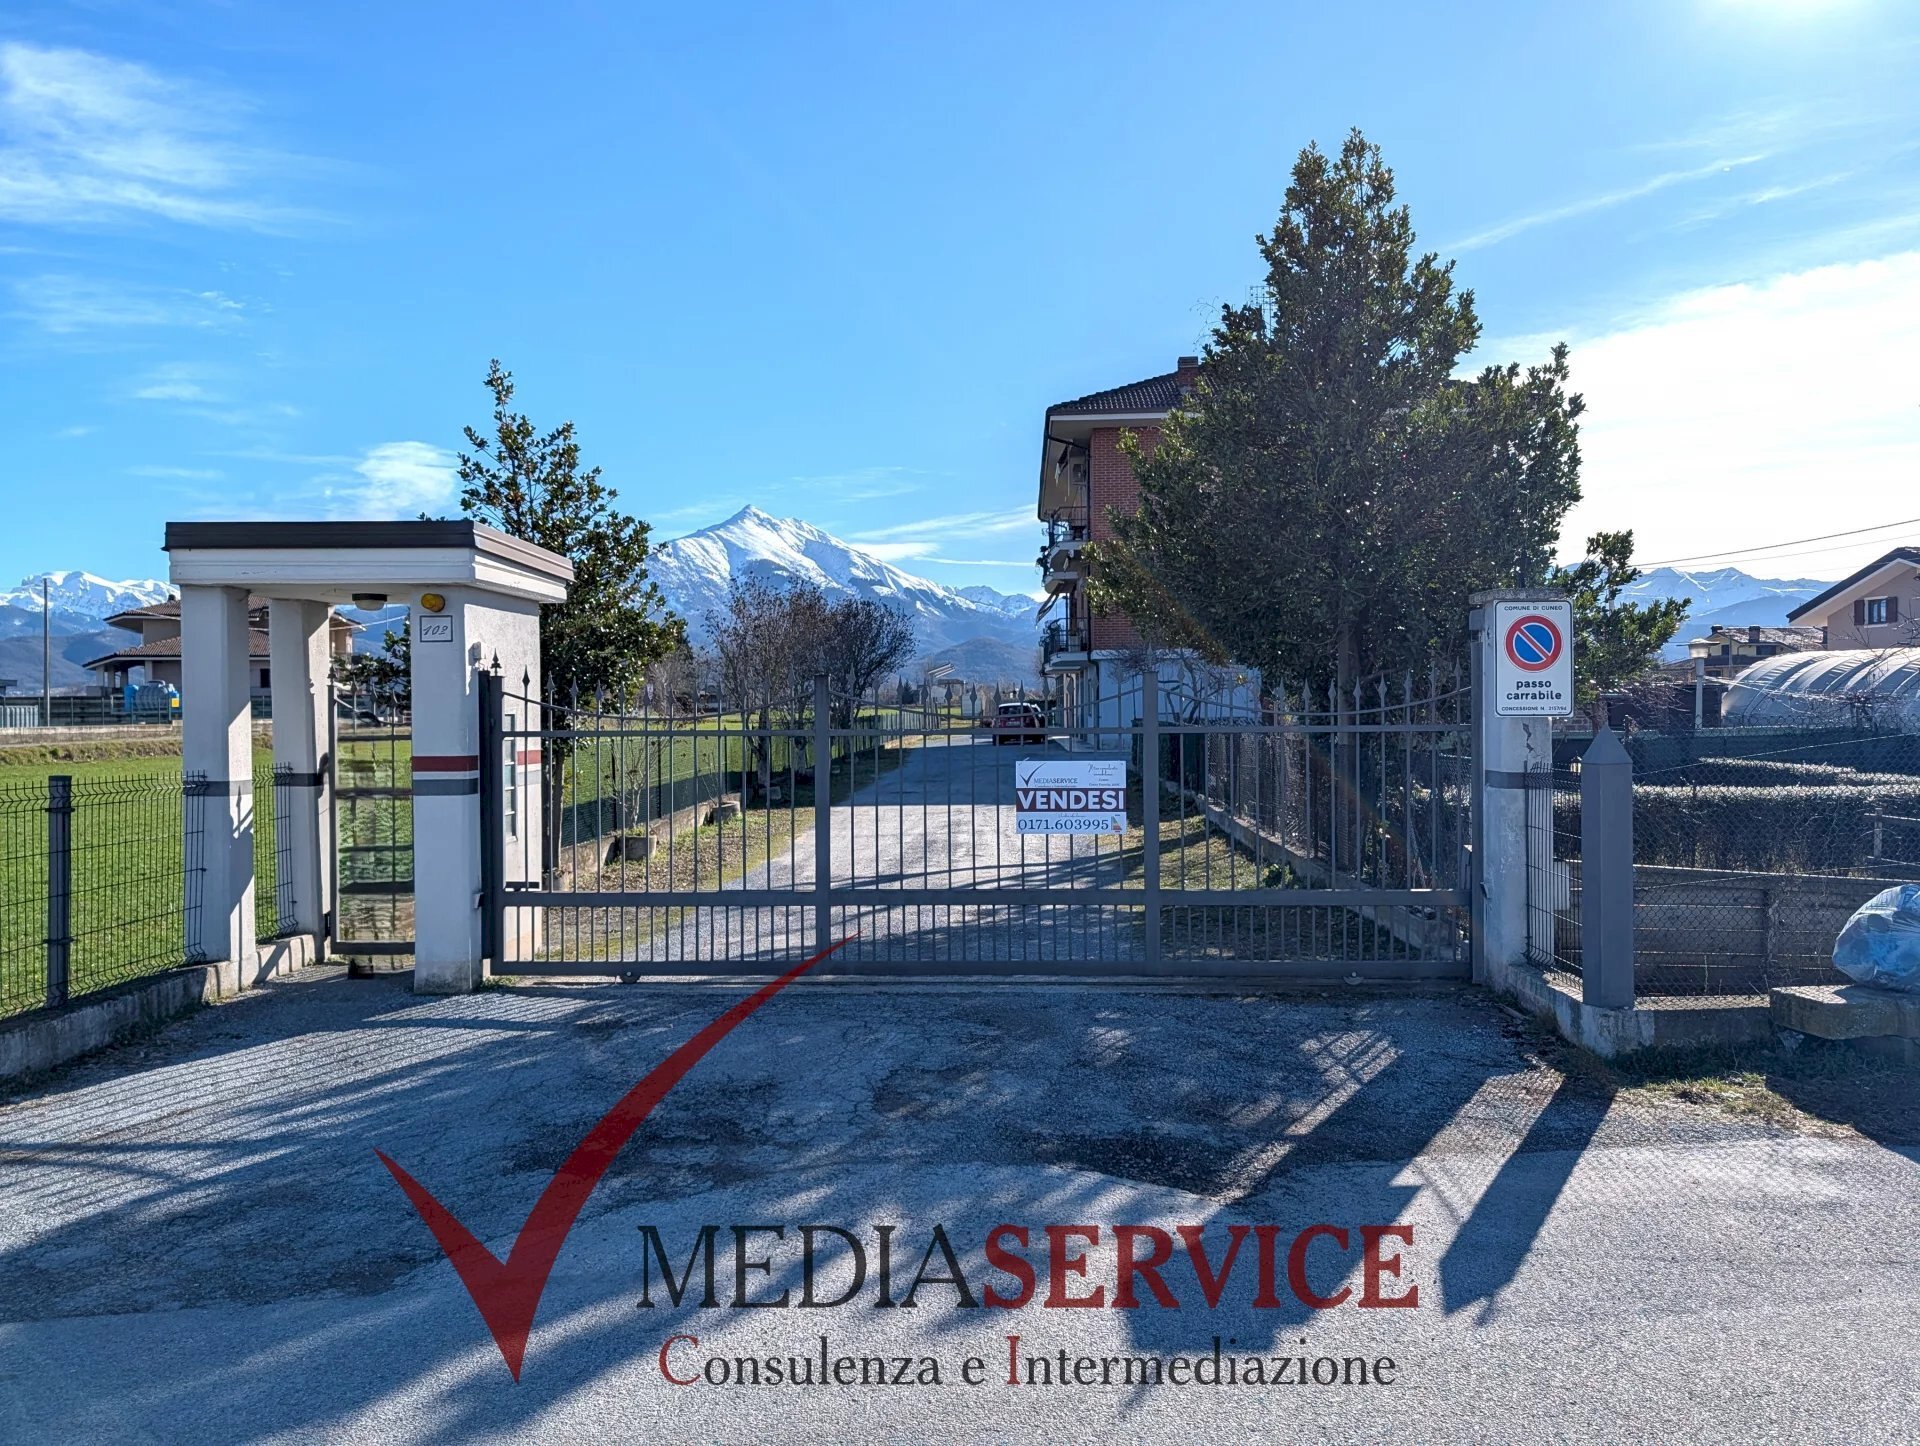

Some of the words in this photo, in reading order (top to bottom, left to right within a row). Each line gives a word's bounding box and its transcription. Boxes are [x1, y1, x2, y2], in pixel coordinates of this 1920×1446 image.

[1516, 680, 1552, 690] passo
[1506, 691, 1562, 700] carrabile
[1017, 790, 1124, 810] VENDESI
[1018, 819, 1109, 831] 0171.603995
